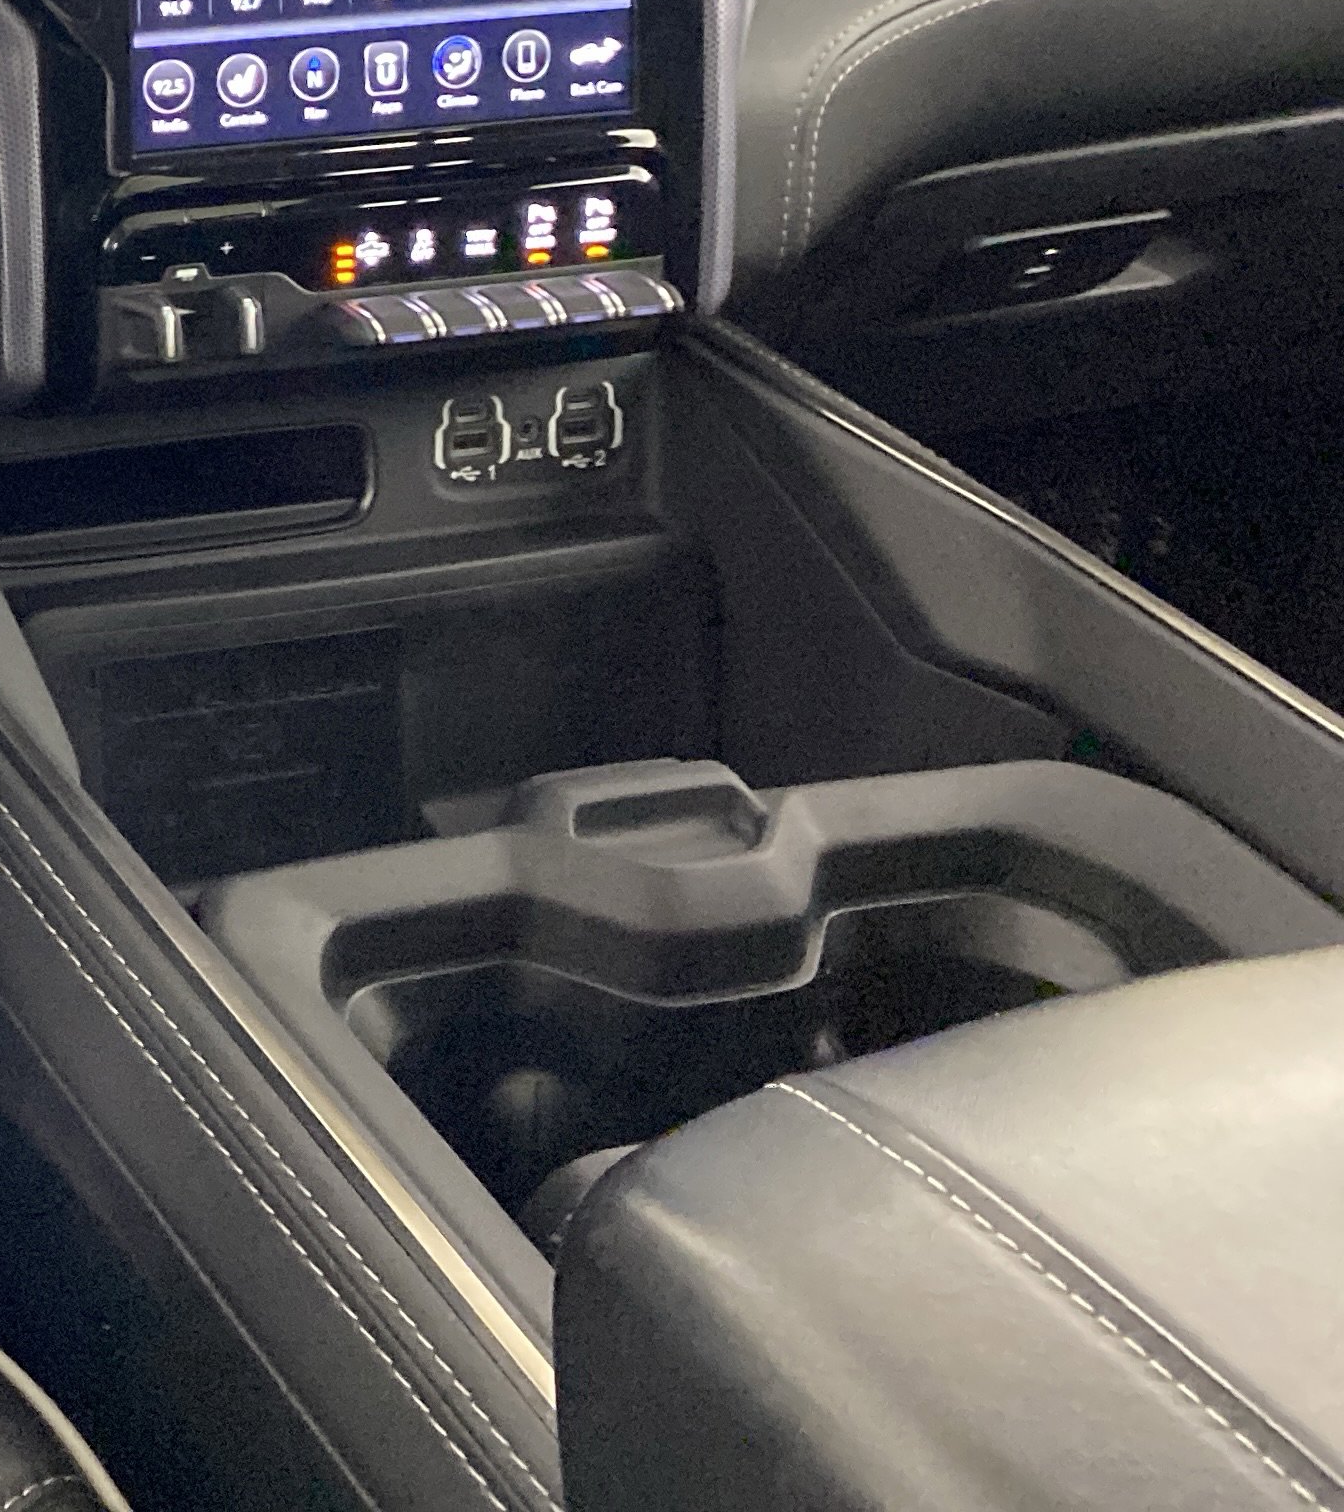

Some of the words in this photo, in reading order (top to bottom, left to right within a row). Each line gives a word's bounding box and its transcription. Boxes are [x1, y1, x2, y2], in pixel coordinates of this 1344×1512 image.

[152, 78, 186, 96] 92.5
[594, 449, 607, 467] 2
[488, 464, 496, 481] 1
